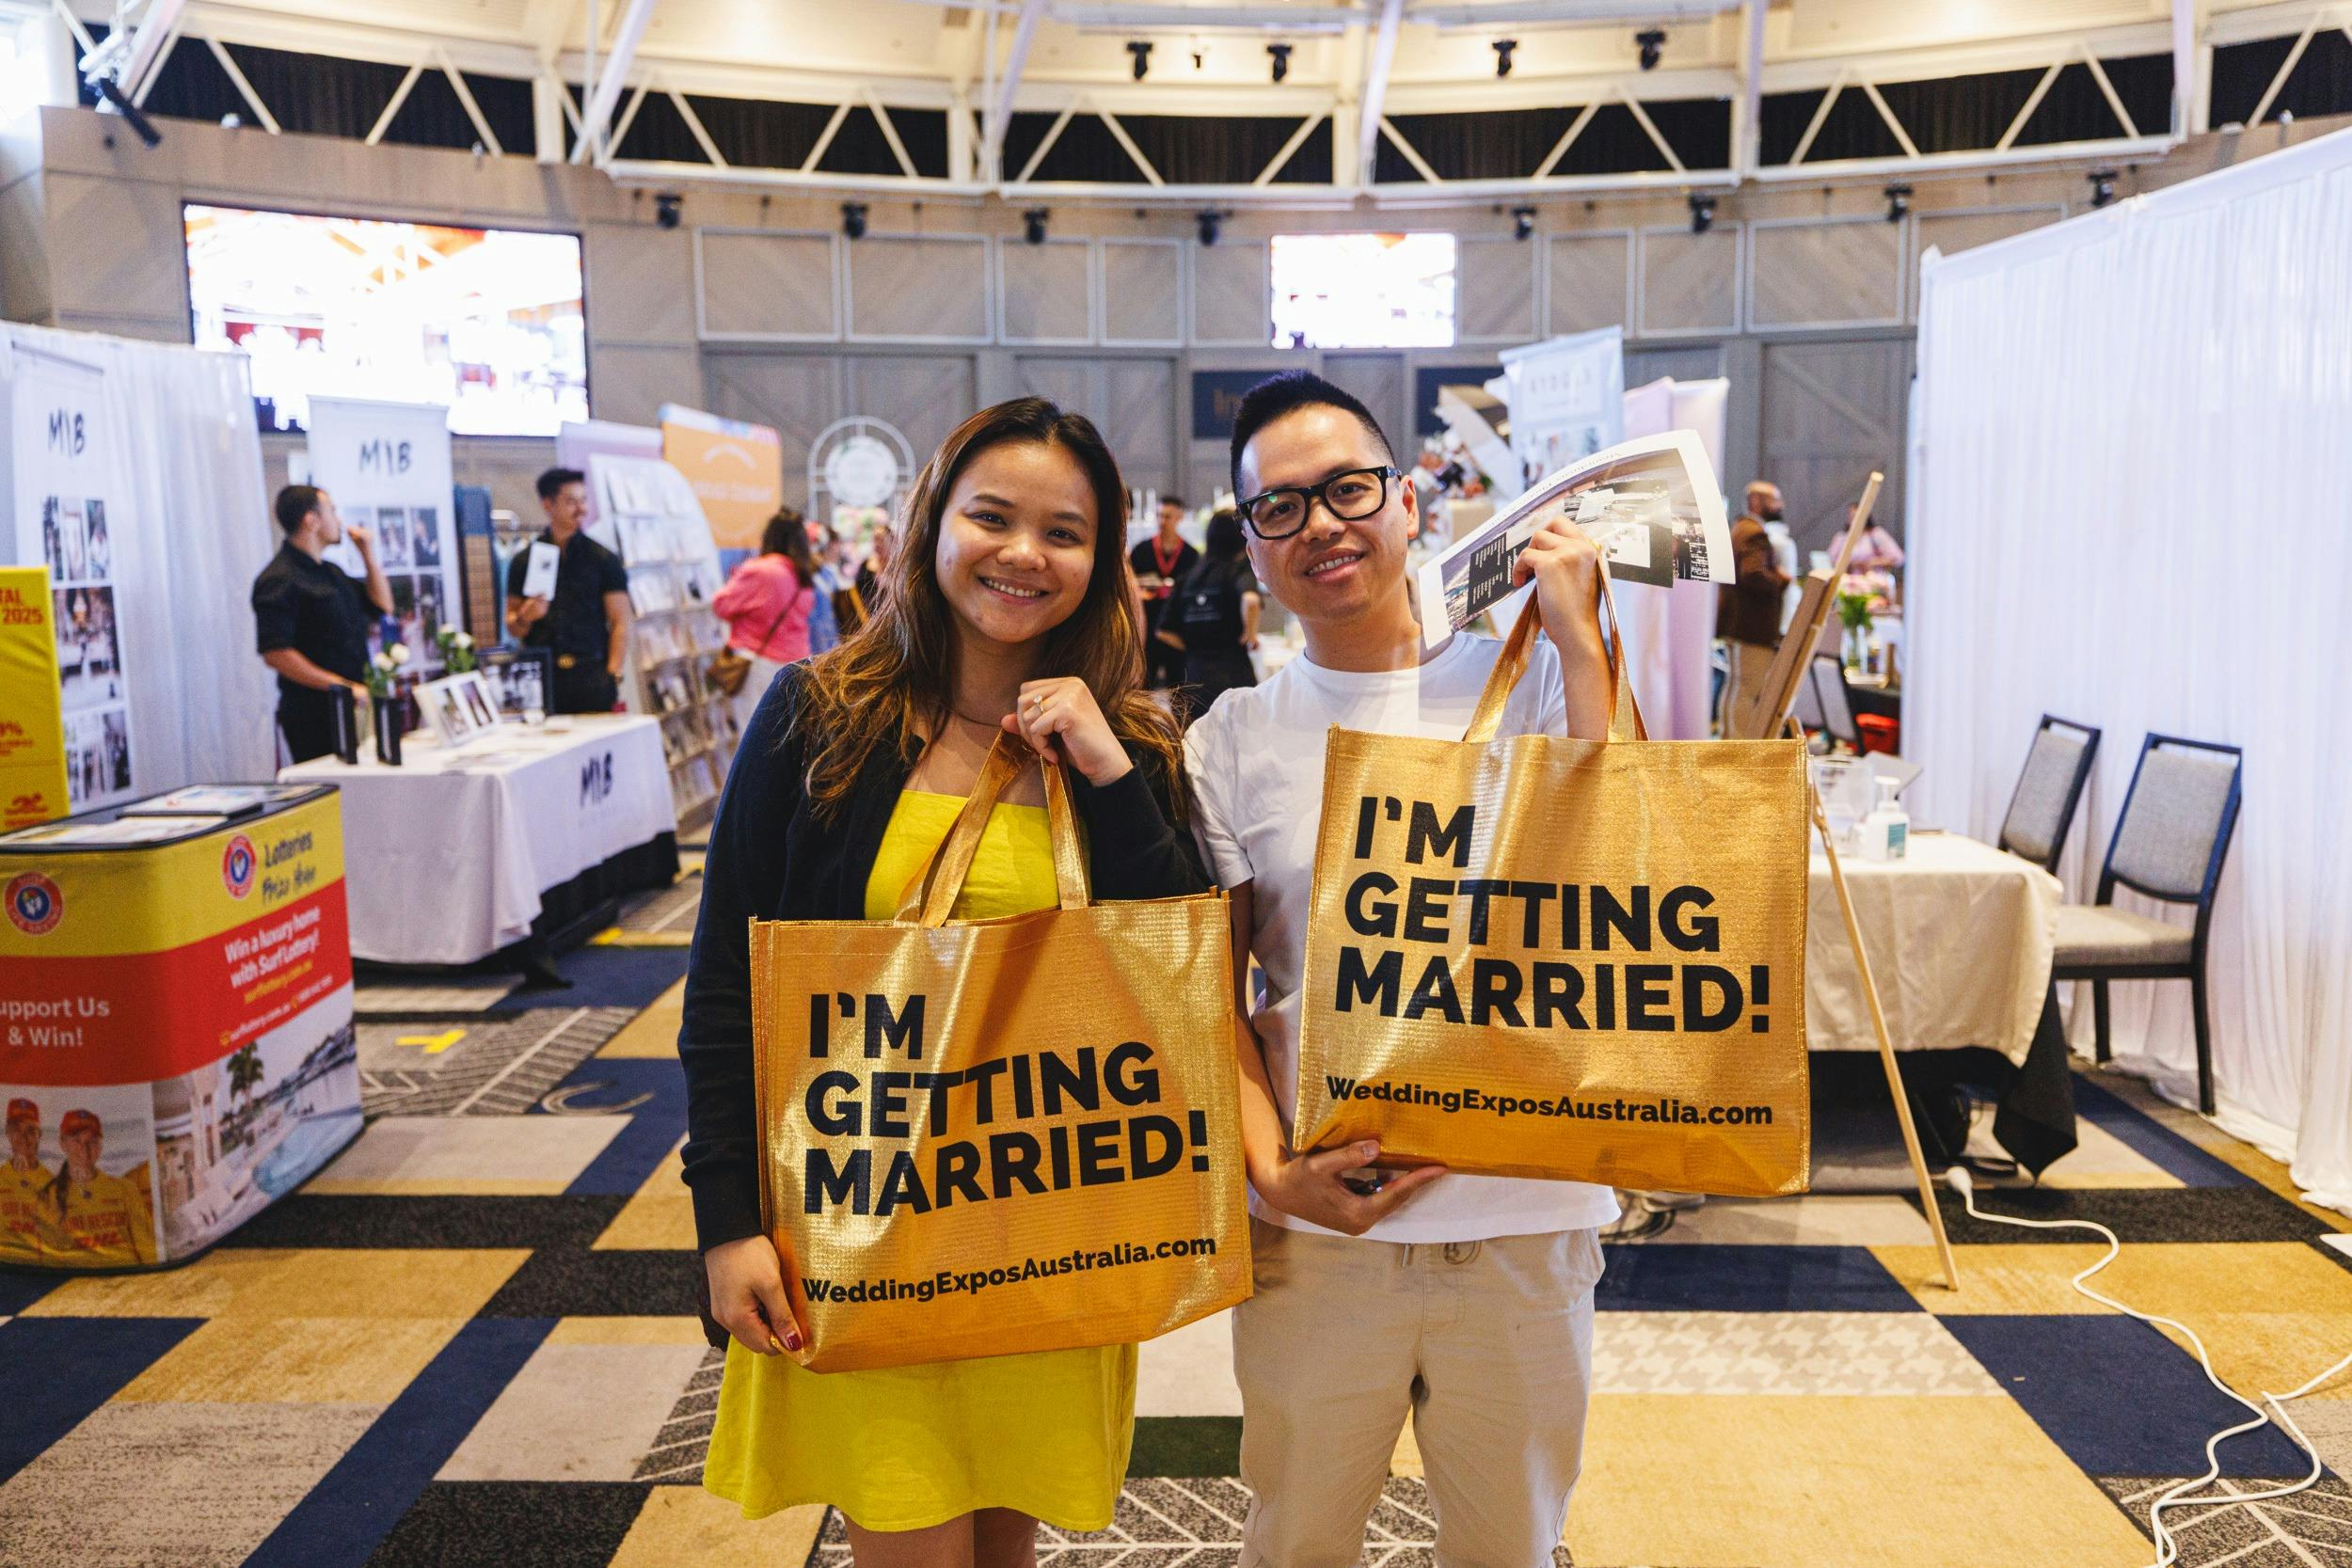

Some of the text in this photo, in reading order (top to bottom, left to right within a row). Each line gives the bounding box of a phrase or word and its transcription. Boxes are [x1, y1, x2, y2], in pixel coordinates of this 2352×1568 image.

[1354, 796, 1475, 867] I'M
[225, 938, 250, 963] Win
[259, 920, 294, 948] luxury
[293, 906, 321, 932] home
[1344, 872, 1720, 952] GETTING
[78, 997, 111, 1017] Us
[230, 960, 259, 988] with
[1335, 946, 1770, 1033] MARRIED!
[8, 1026, 83, 1047] & Win!
[809, 992, 926, 1060] I'M
[804, 1041, 1160, 1138] GETTING
[1326, 1075, 1772, 1125] WeddingExposAustralia.com
[803, 1110, 1210, 1216] MARRIED!
[802, 1237, 1216, 1303] WeddingExposAustralia.com
